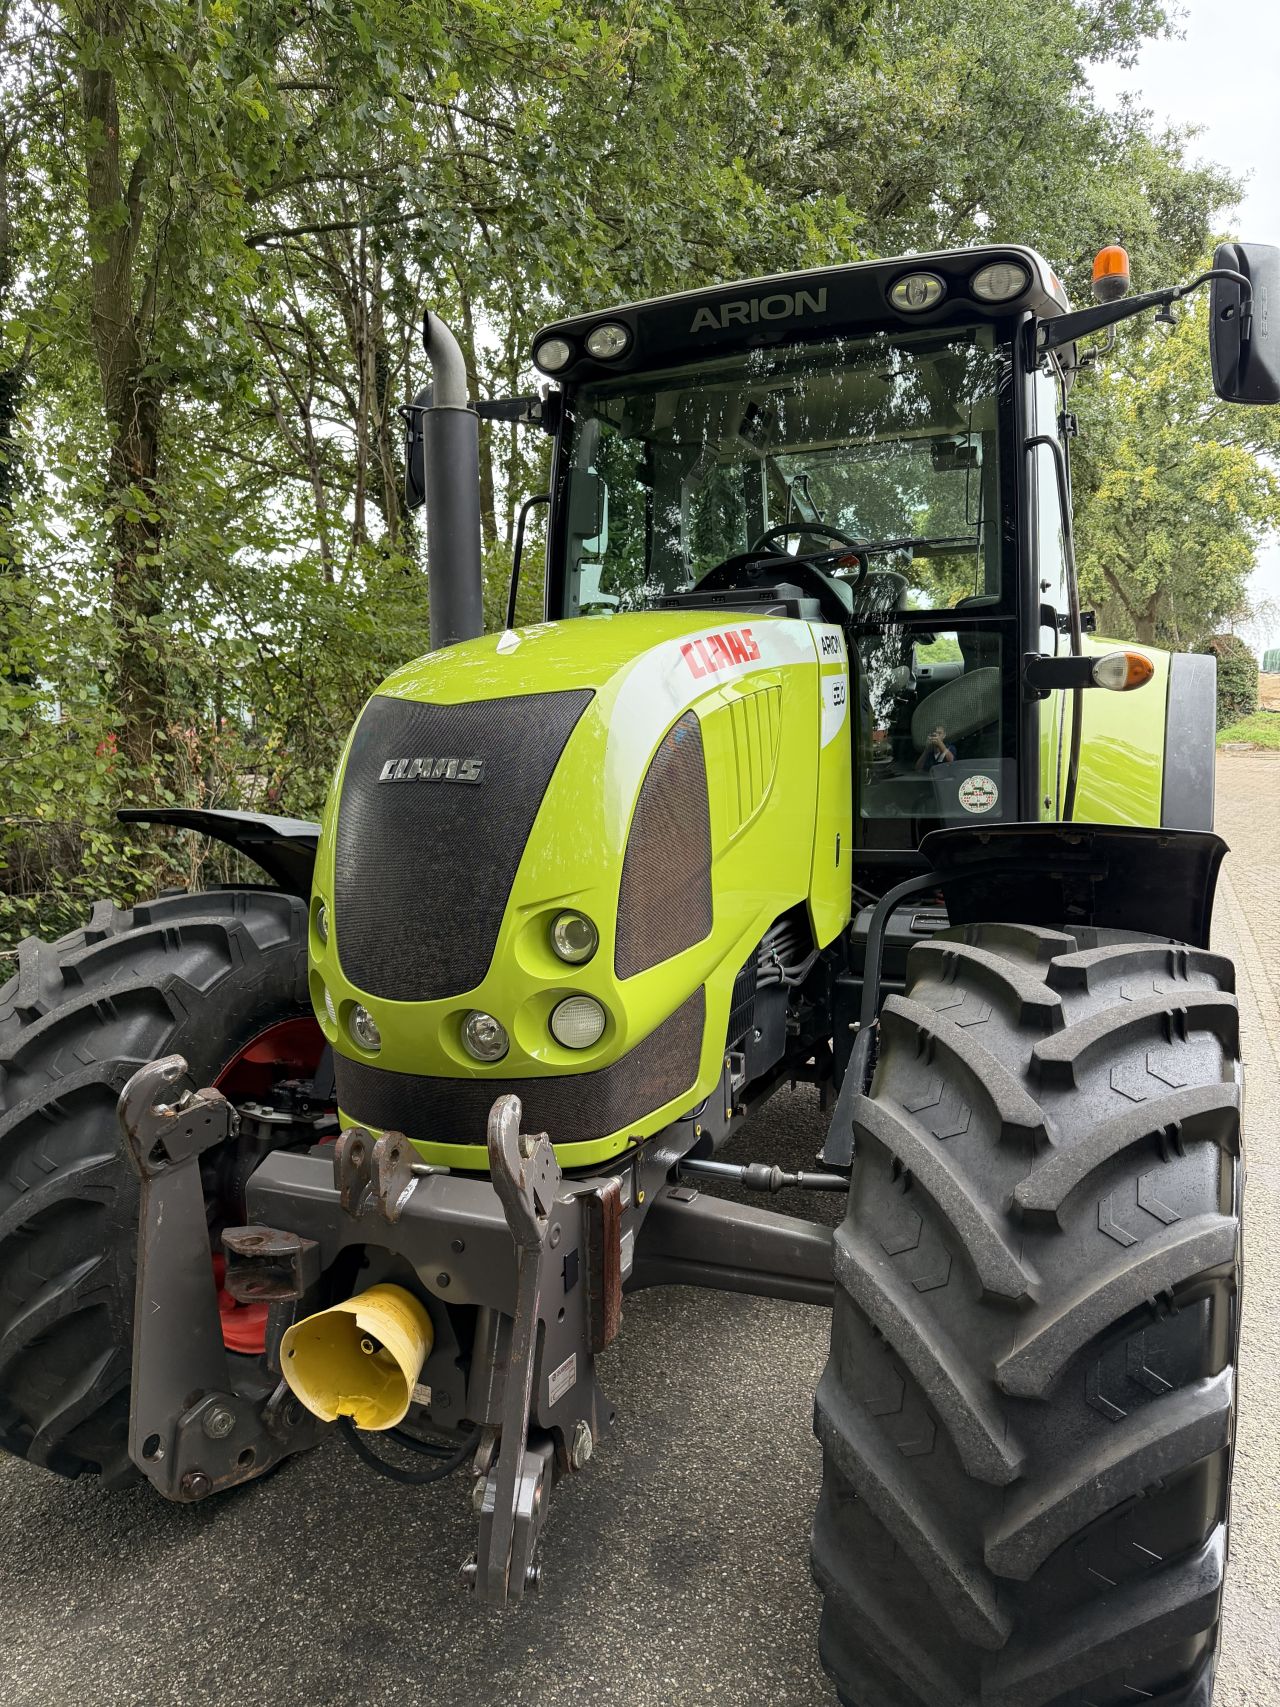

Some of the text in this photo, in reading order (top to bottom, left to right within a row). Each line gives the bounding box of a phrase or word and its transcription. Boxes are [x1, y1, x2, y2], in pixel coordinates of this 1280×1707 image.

[689, 288, 827, 332] ARION
[680, 629, 761, 679] CLAAS
[379, 759, 483, 784] CLAAS
